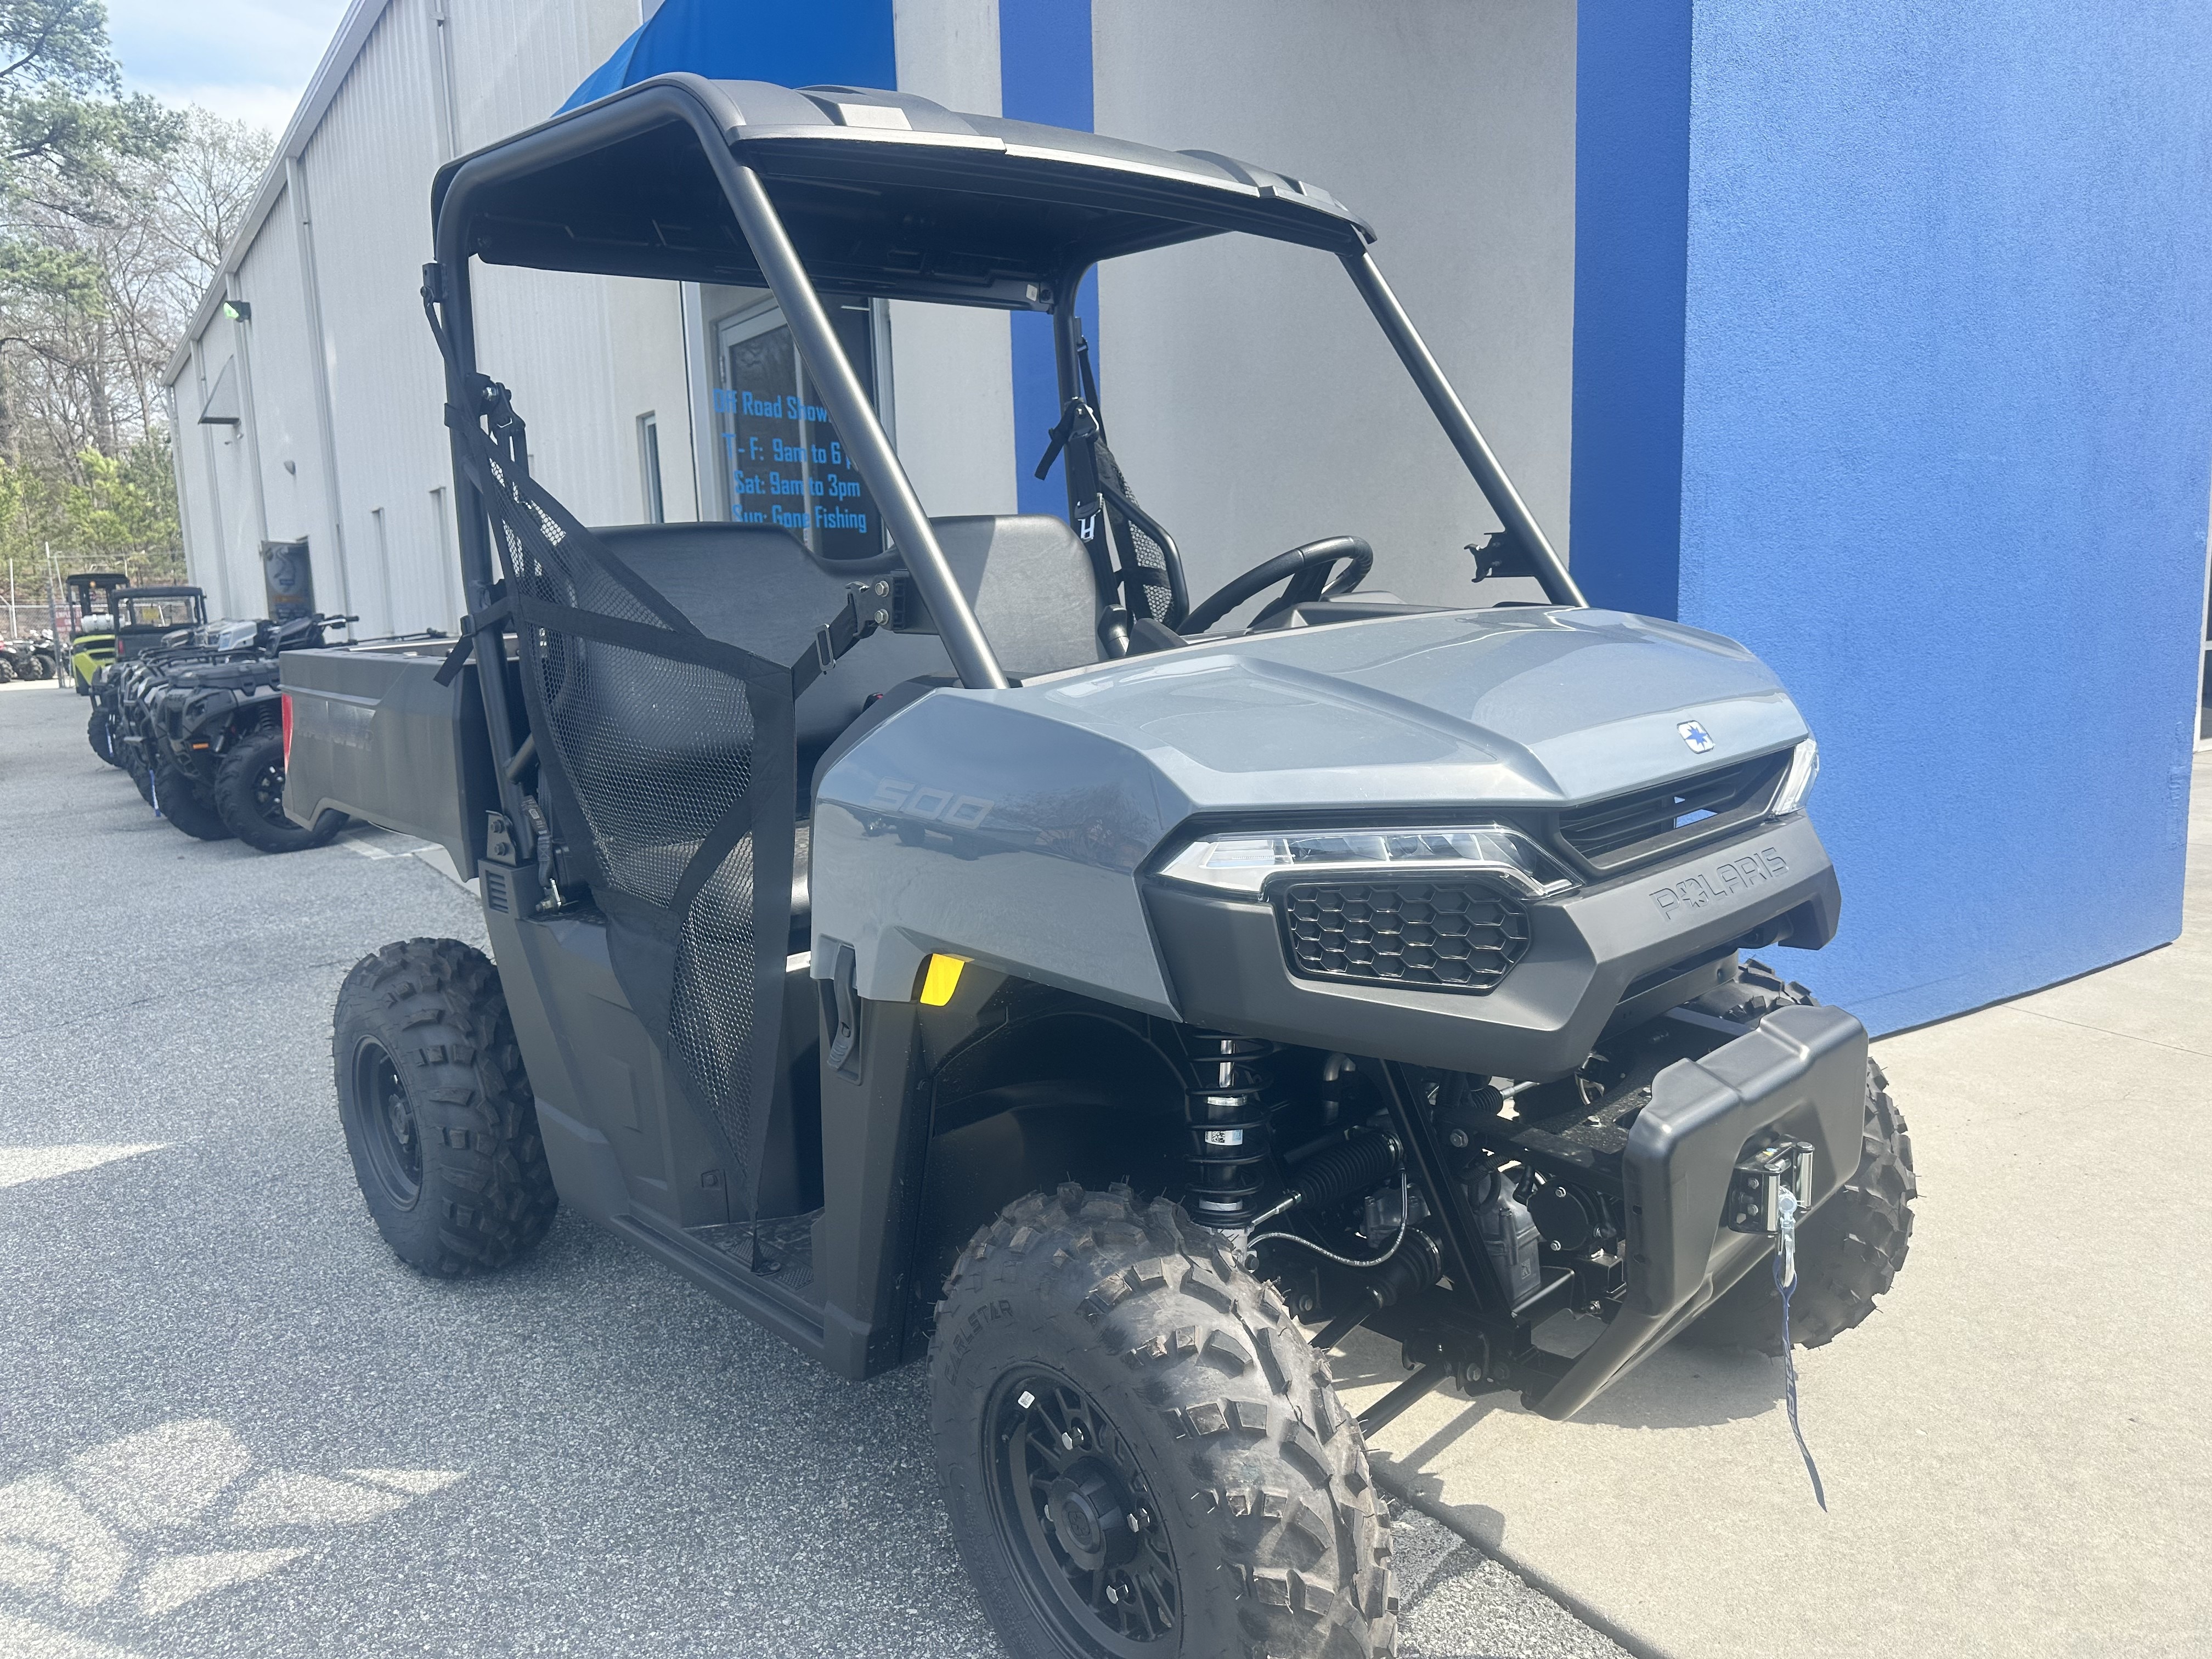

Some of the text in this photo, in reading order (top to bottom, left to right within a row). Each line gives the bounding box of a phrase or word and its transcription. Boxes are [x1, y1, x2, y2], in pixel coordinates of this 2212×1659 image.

[713, 388, 829, 422] Off Road Show
[722, 433, 736, 460] T
[749, 437, 764, 461] F:
[772, 438, 807, 462] 9am
[811, 444, 827, 464] to
[831, 442, 841, 465] 6
[733, 470, 861, 501] Sat: 9am to 3pm
[771, 505, 810, 528] Gone
[815, 506, 867, 533] Fishing
[867, 776, 995, 830] 500
[1649, 847, 1790, 921] POLARIS
